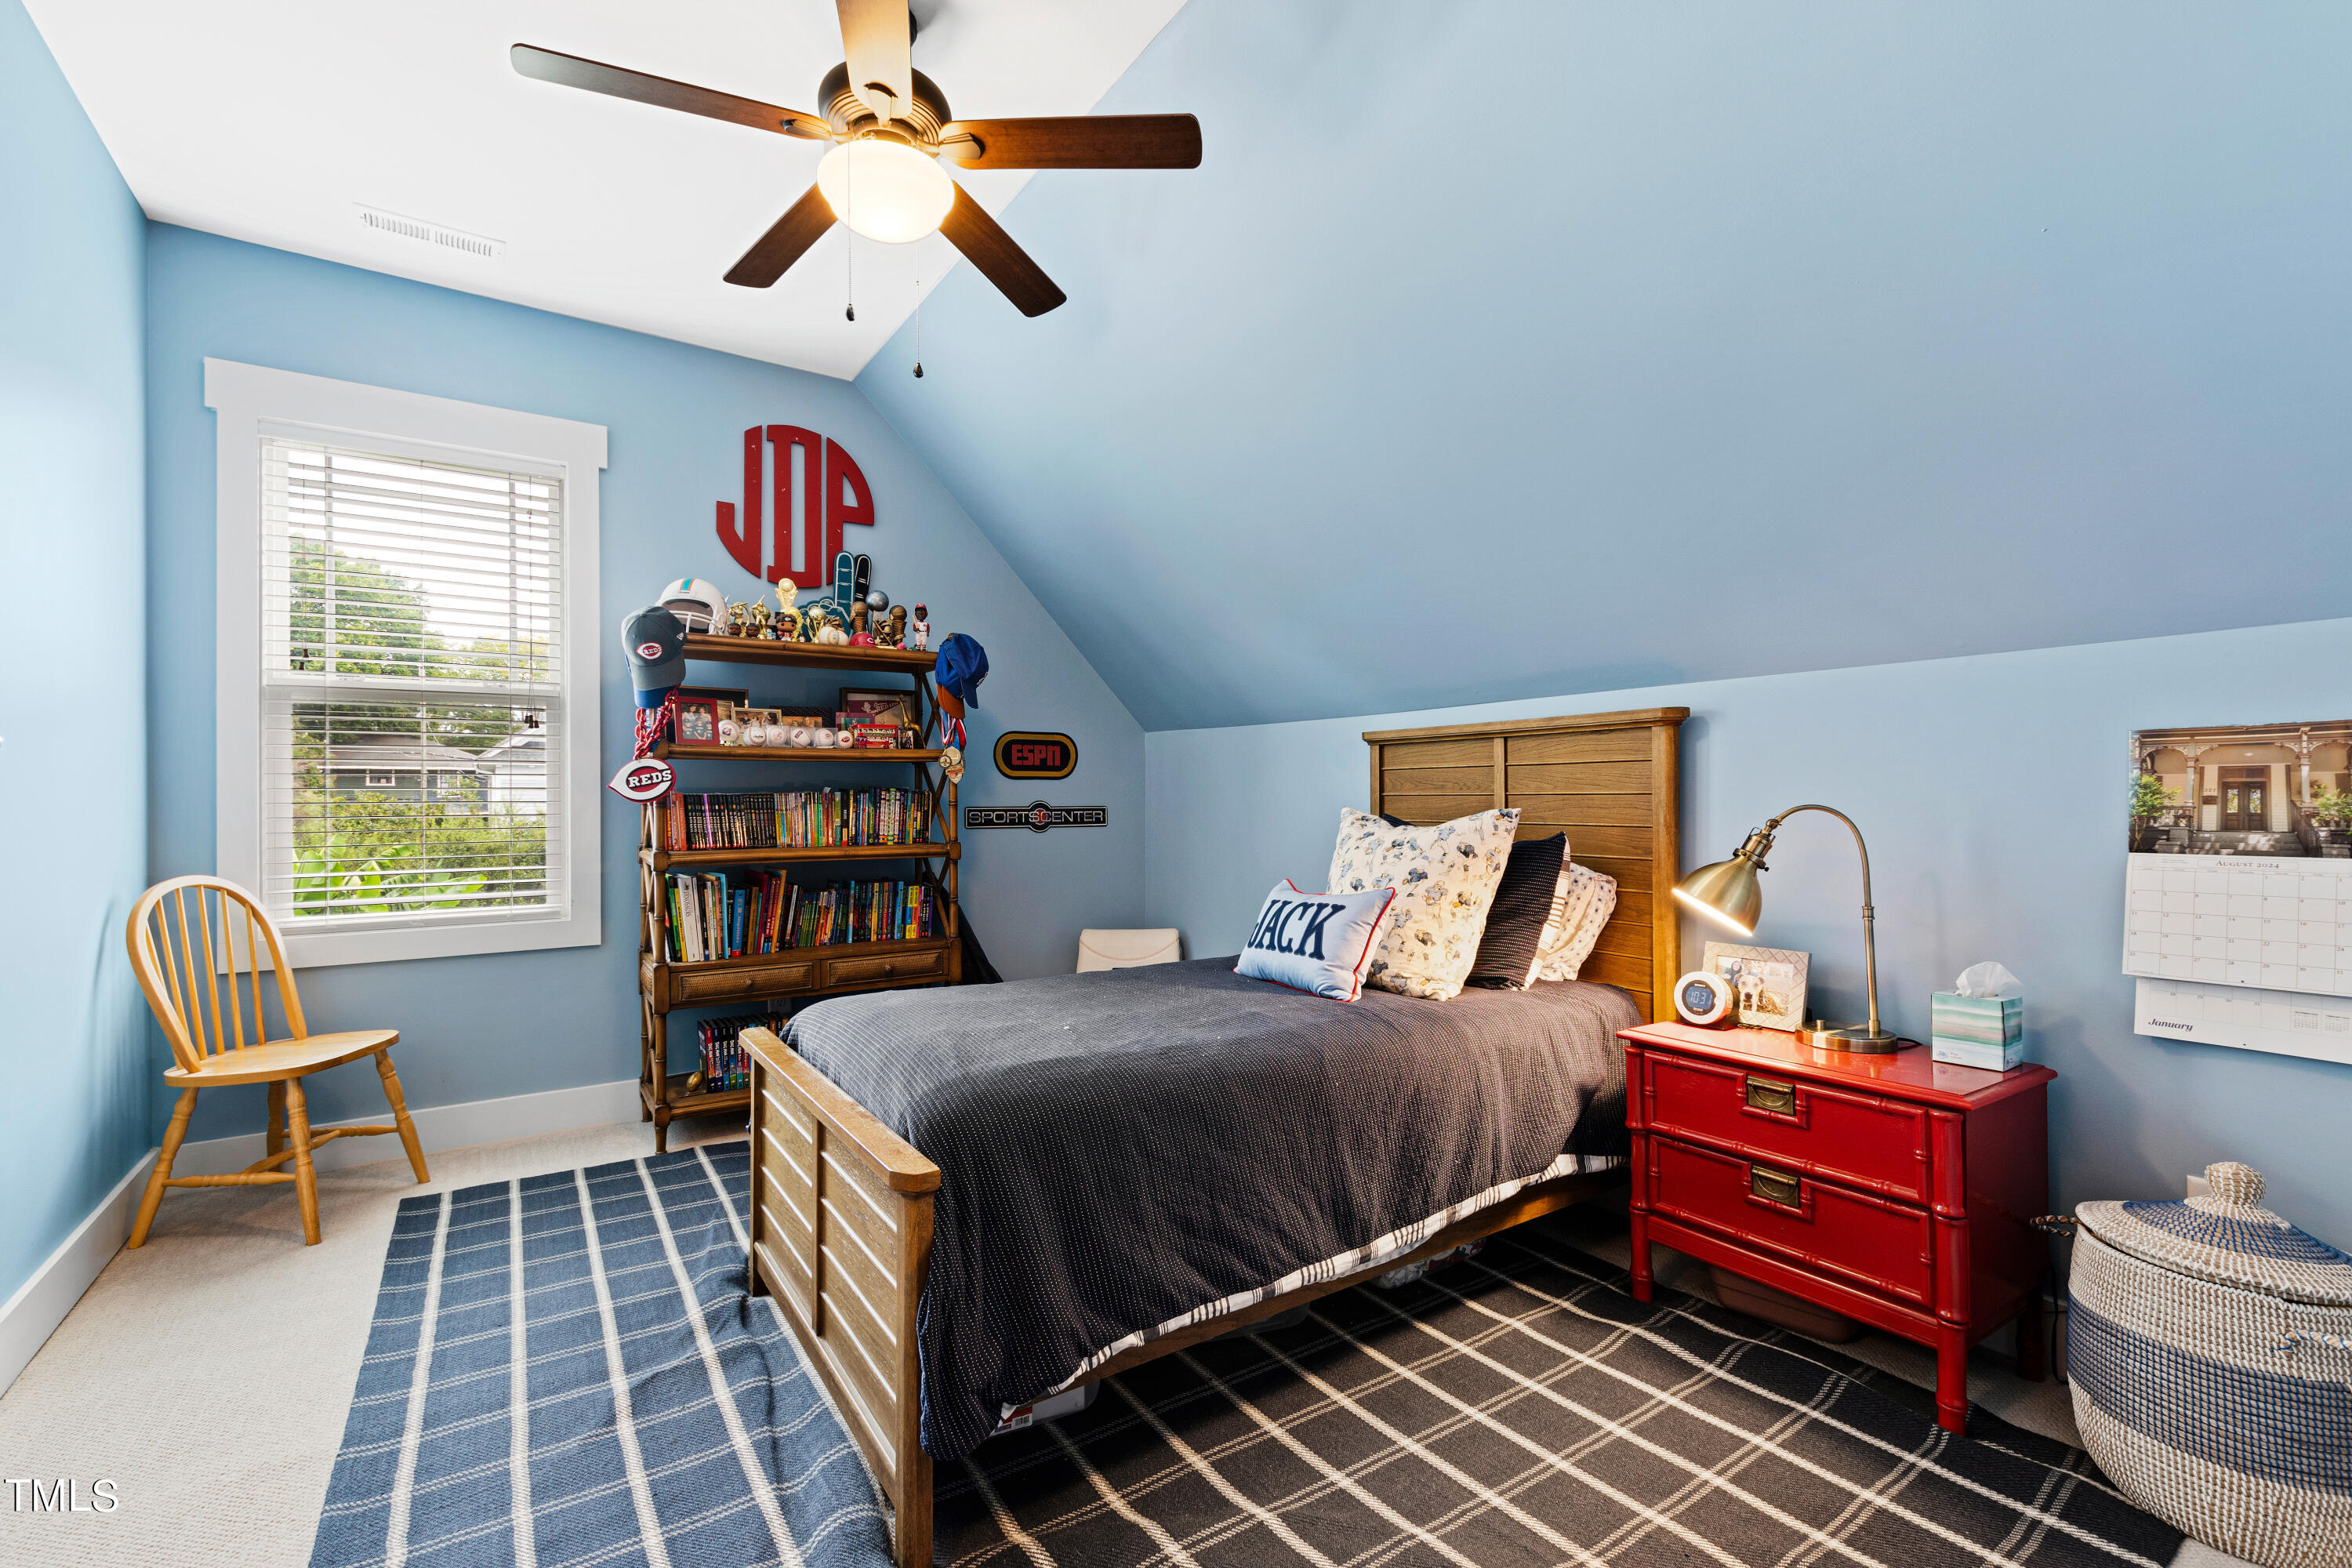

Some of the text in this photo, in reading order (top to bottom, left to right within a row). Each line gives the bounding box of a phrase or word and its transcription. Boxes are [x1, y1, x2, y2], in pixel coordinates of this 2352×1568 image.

[643, 646, 662, 655] REDS
[1011, 744, 1061, 766] ESPN
[628, 770, 673, 788] REDS
[969, 811, 1103, 823] SPORTSCENTER
[683, 891, 691, 917] DINOSAURS
[1247, 899, 1346, 960] JACK
[2148, 1018, 2194, 1032] January
